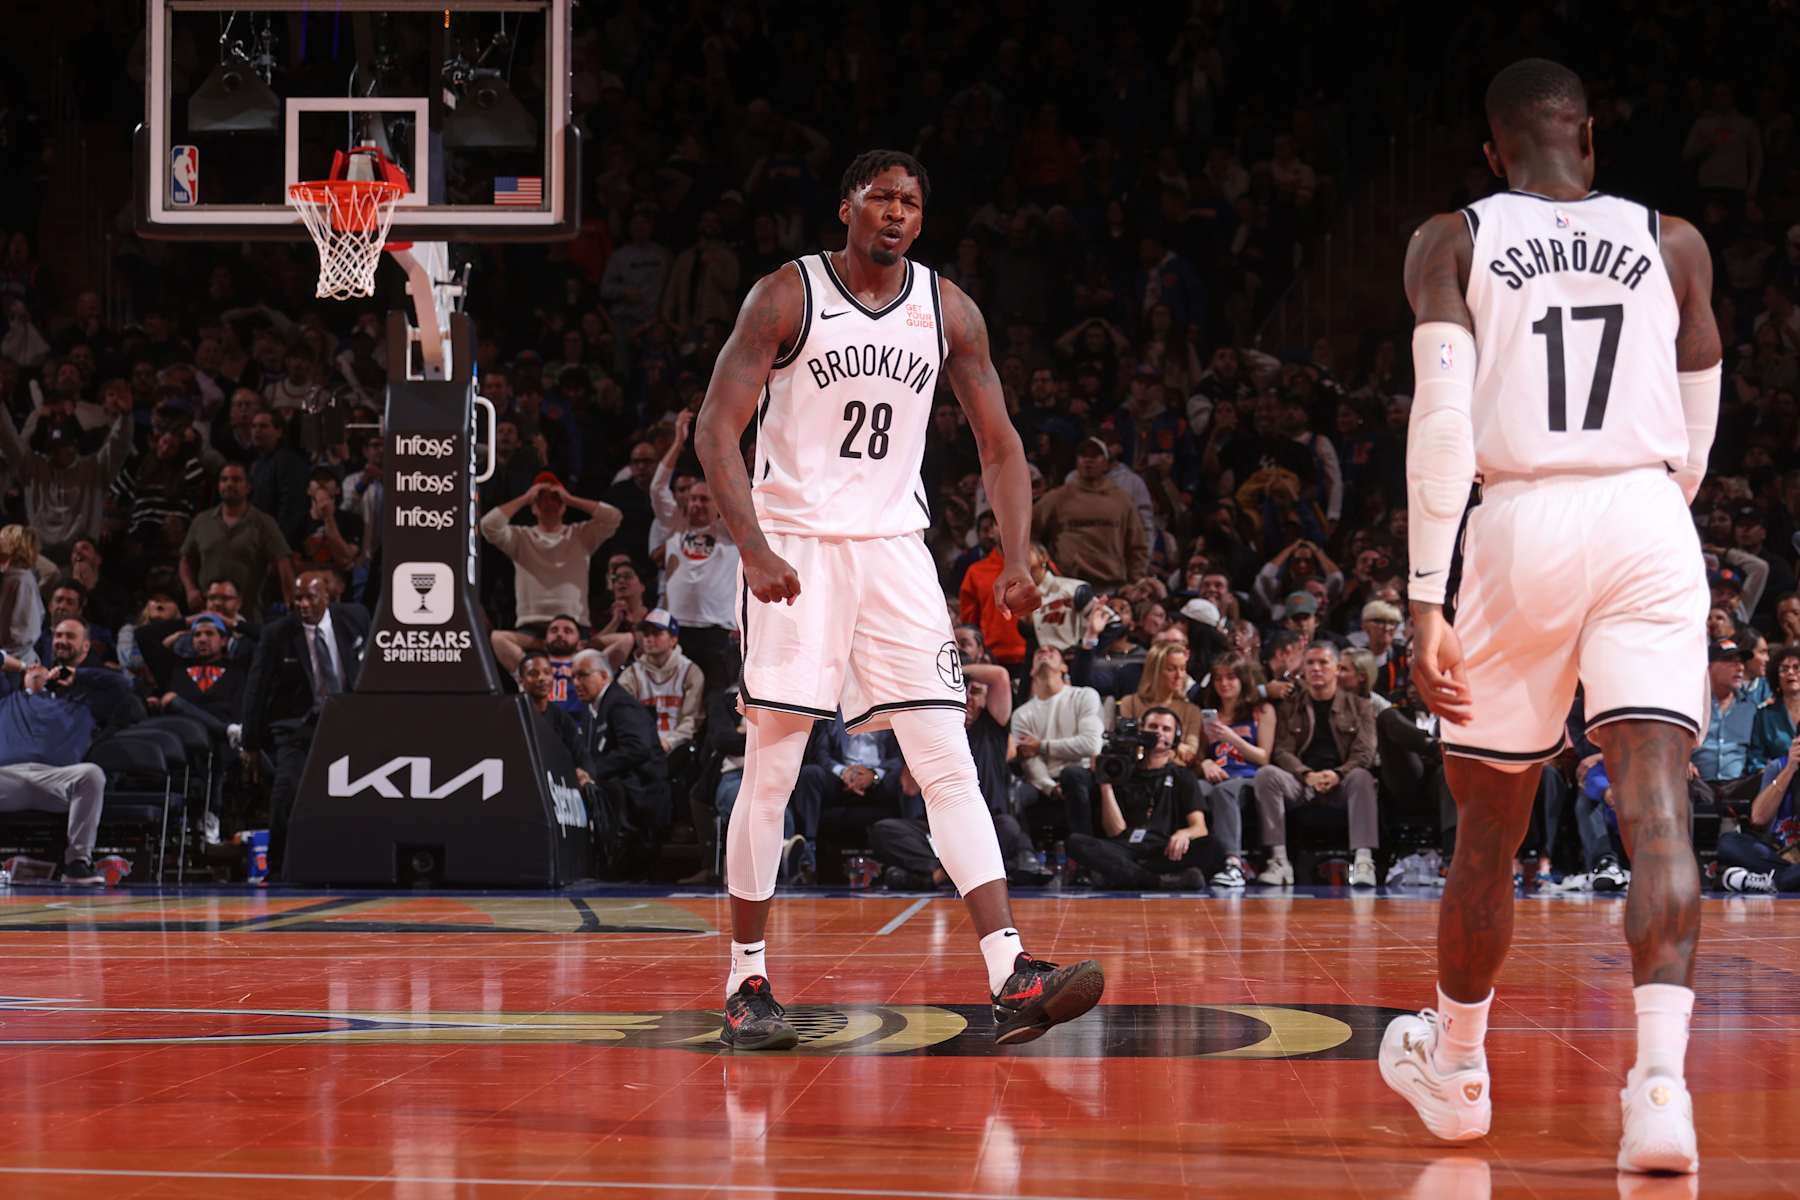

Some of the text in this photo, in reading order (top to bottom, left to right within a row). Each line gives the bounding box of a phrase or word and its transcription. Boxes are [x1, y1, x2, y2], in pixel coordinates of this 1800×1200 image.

[1489, 230, 1652, 291] SCHRÖDER
[905, 303, 921, 311] GET
[907, 311, 931, 320] YOUR
[906, 319, 934, 328] GUIDE
[807, 344, 934, 395] BROOKLYN
[1532, 303, 1624, 432] 17
[839, 400, 893, 460] 28
[396, 435, 454, 459] Infosys
[396, 471, 455, 495] Infosys
[396, 506, 455, 530] Infosys
[375, 630, 471, 649] CAESARS
[383, 648, 461, 662] SPORTSBOOK
[328, 754, 503, 801] KIA
